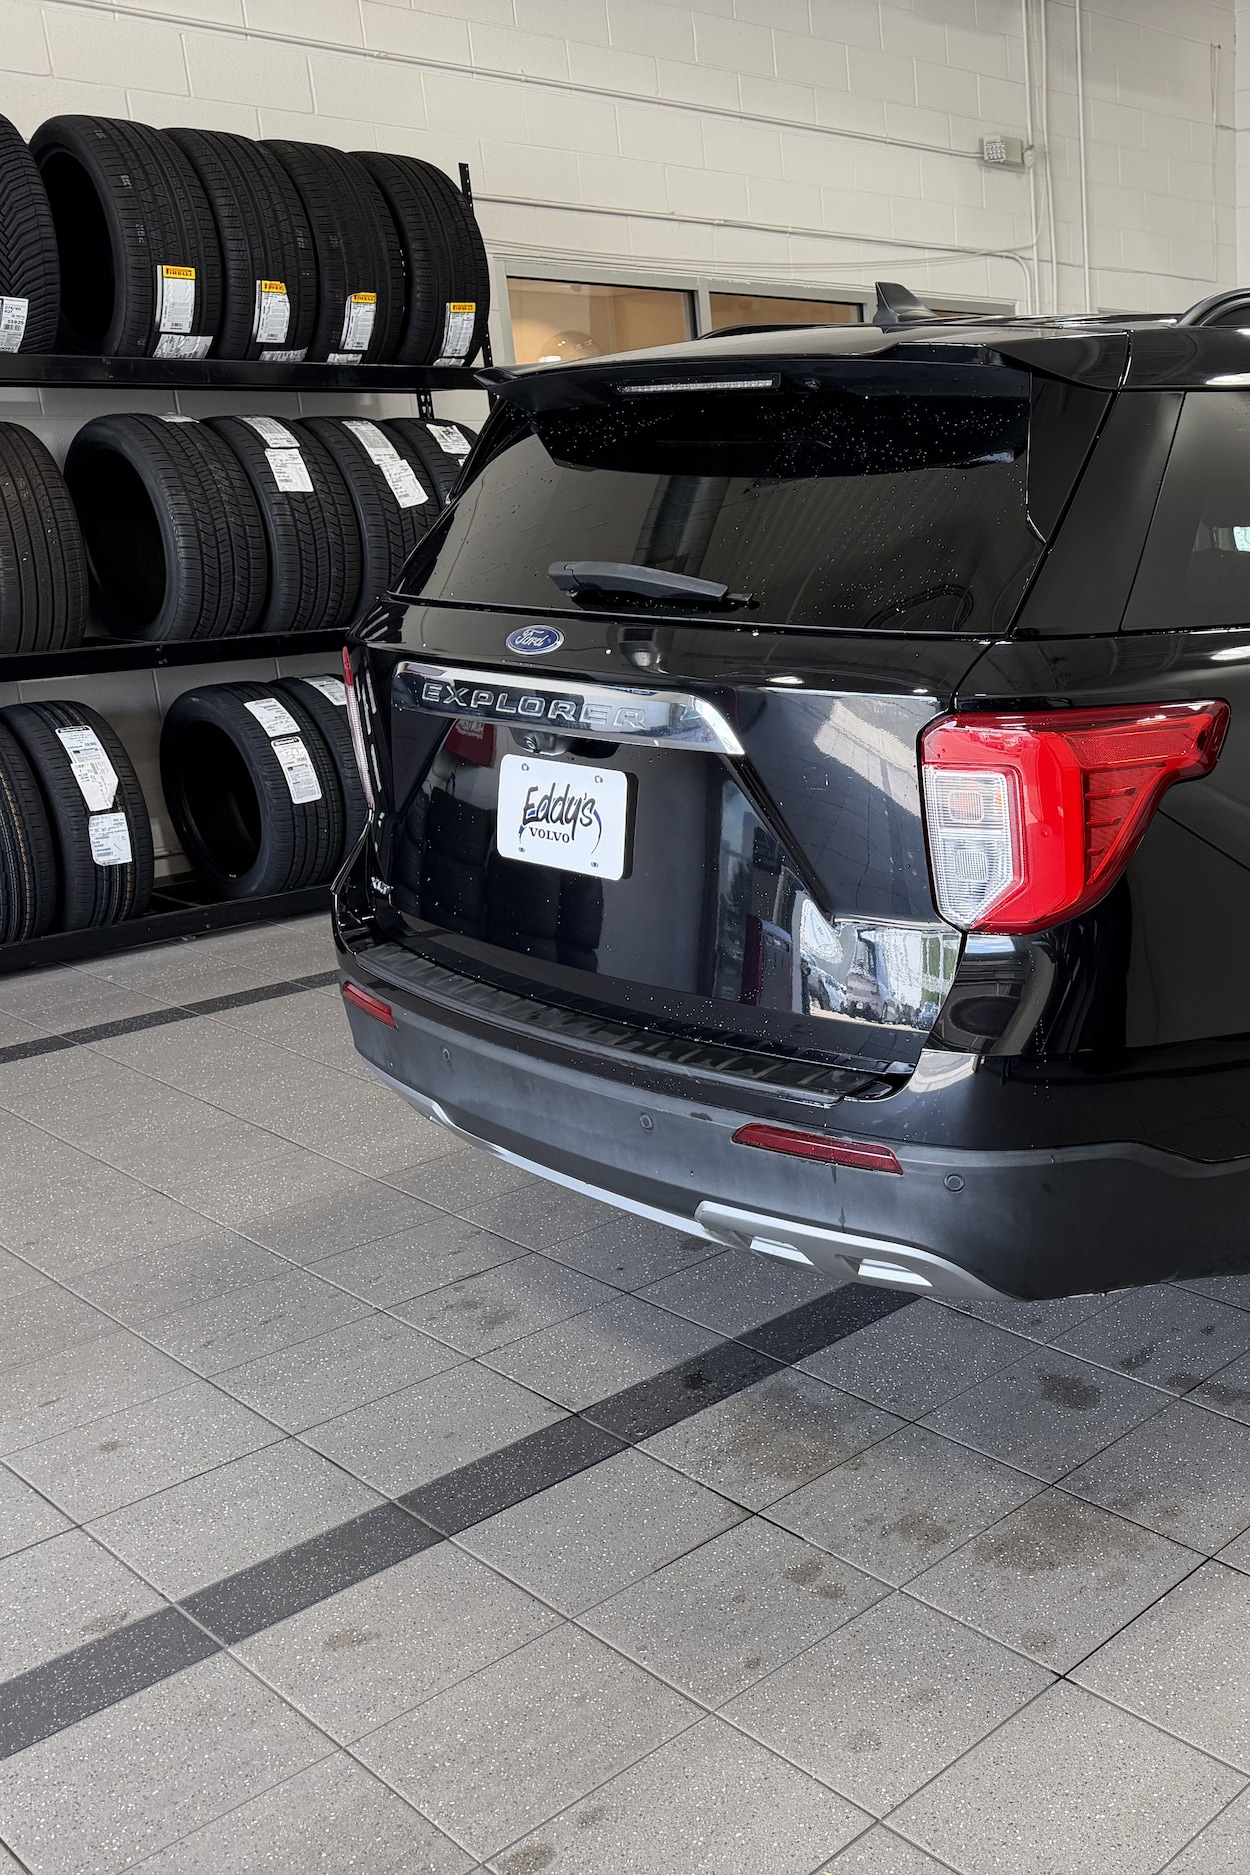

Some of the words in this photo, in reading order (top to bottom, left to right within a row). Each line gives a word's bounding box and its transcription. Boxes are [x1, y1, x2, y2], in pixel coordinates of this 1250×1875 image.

[165, 267, 192, 277] PIRELLI
[515, 629, 550, 647] Ford
[422, 676, 646, 730] EXPLORER
[523, 782, 596, 841] Eddy's
[529, 826, 570, 843] VOLVO
